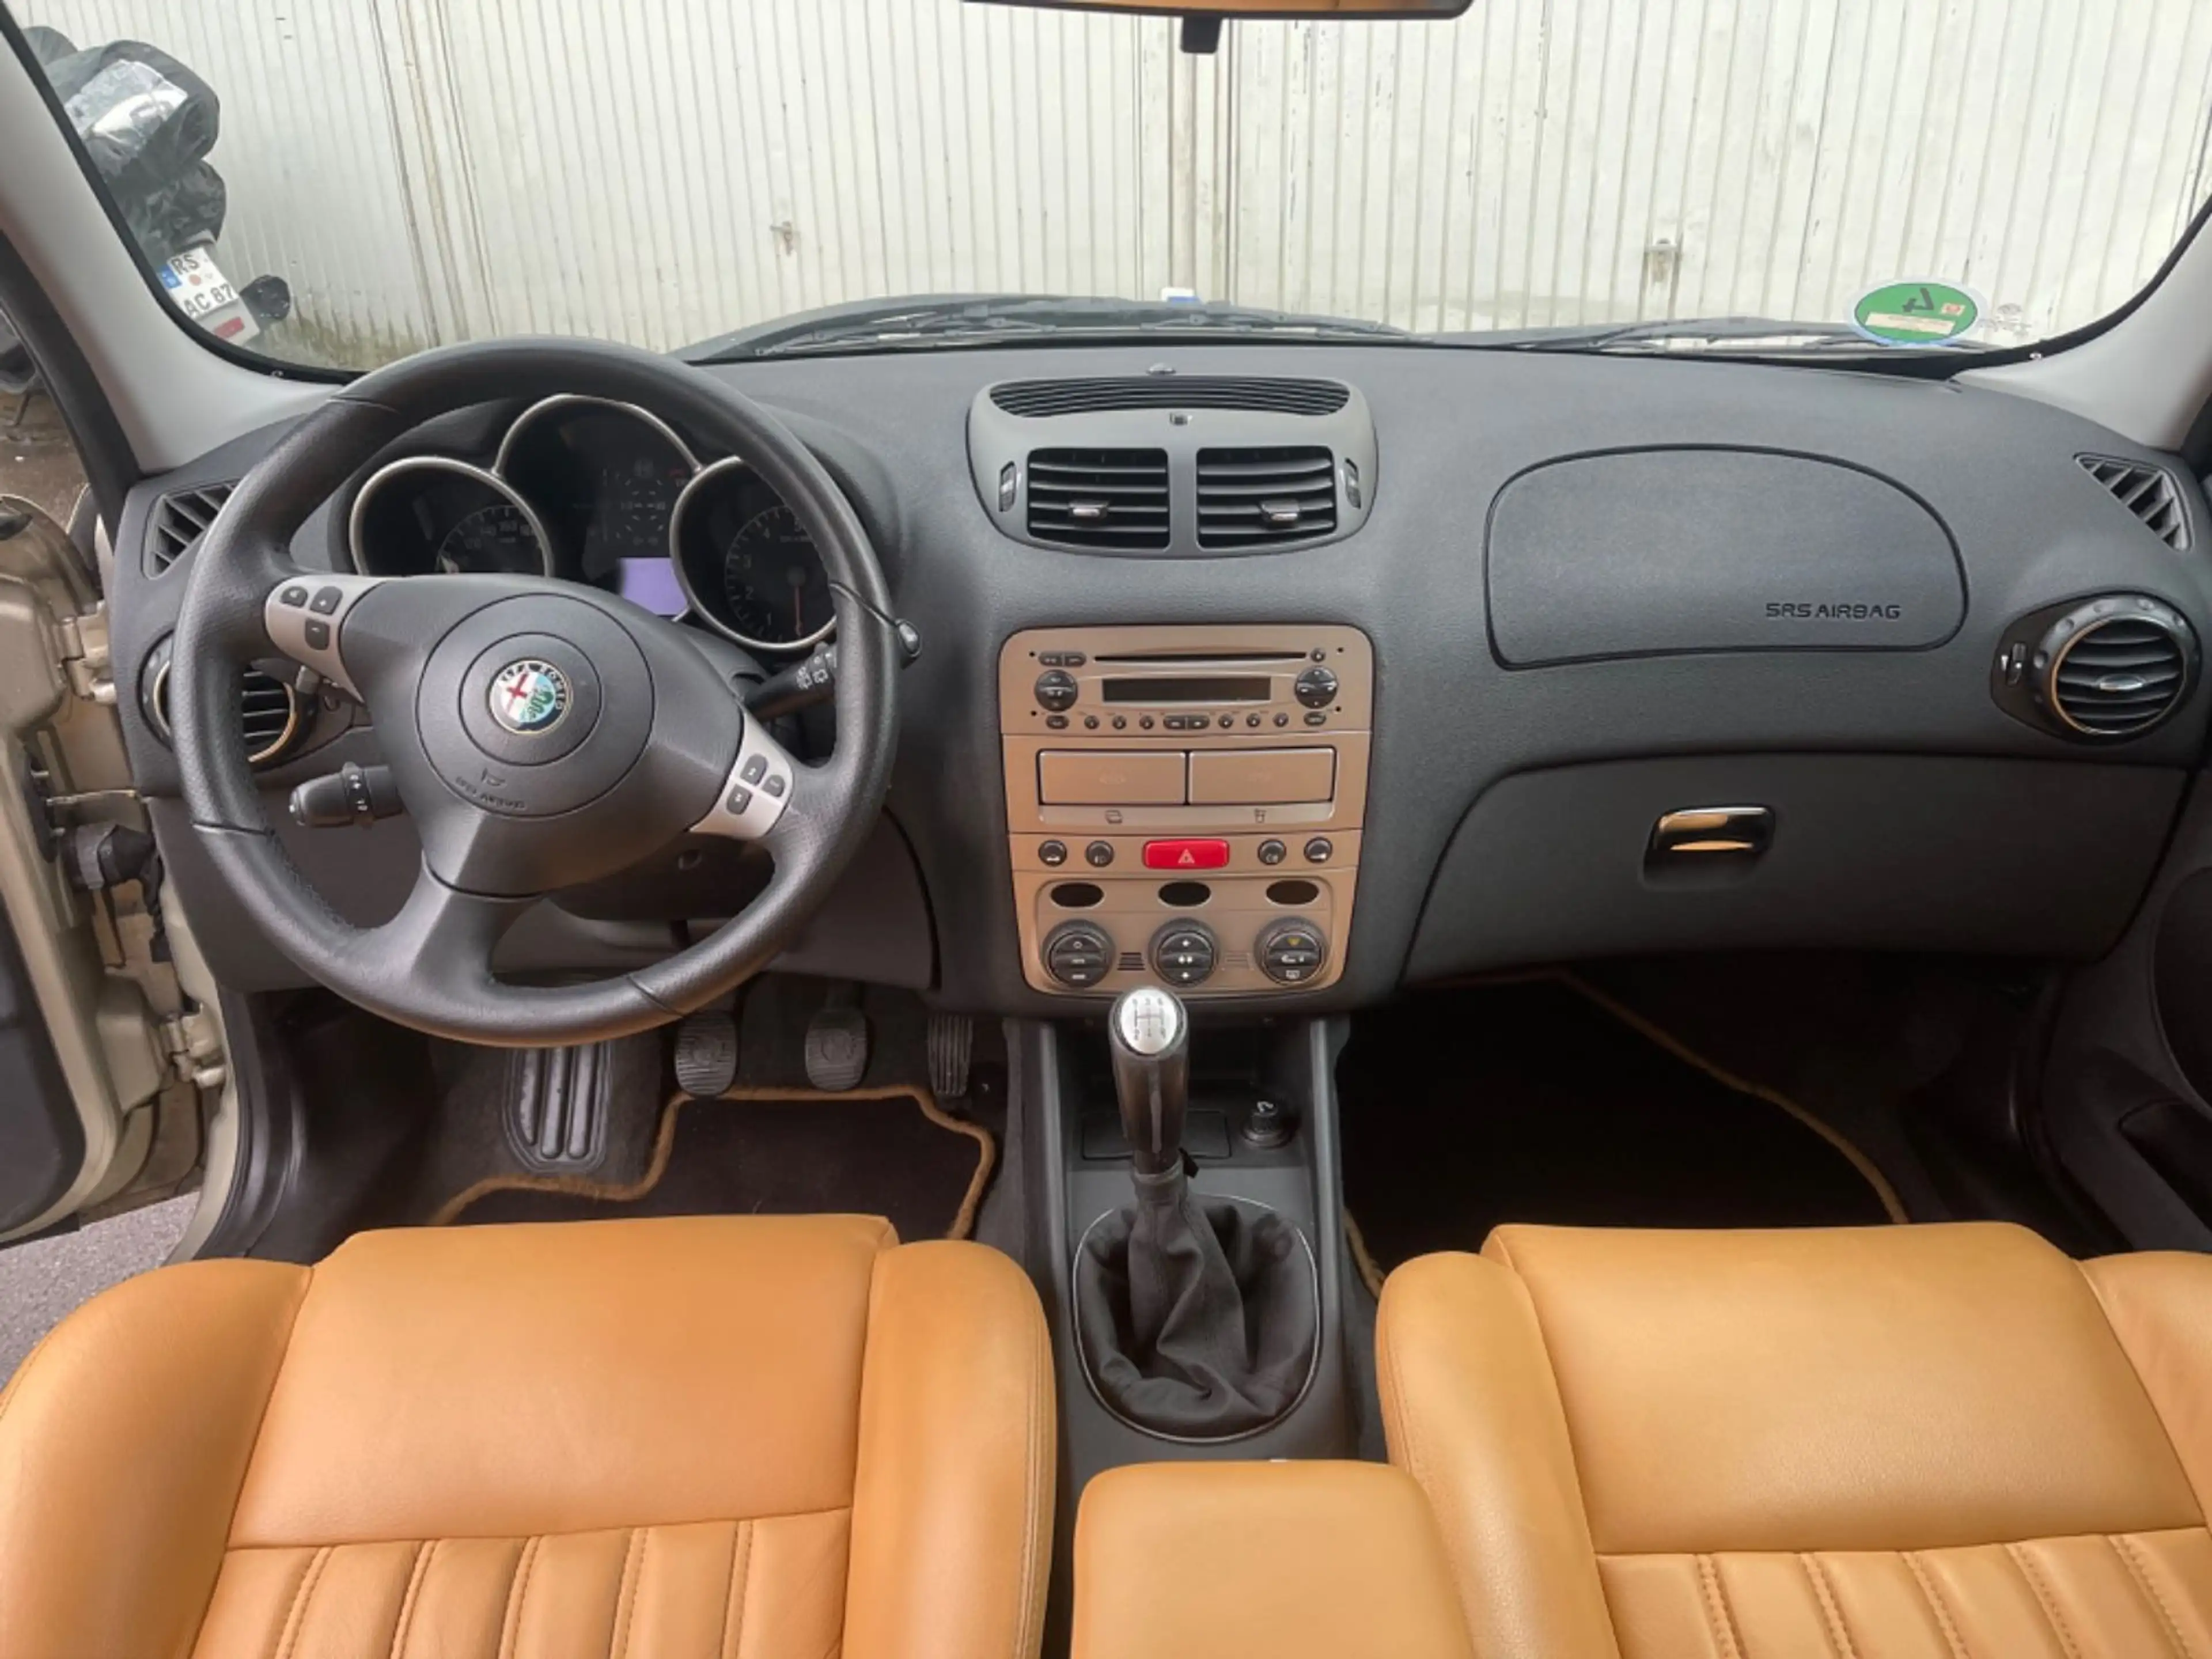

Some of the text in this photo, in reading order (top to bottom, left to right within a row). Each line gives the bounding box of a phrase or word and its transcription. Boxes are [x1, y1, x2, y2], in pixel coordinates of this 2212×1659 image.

[171, 255, 200, 275] RS
[183, 293, 211, 317] AC
[1766, 603, 1900, 619] SRS AIRBAG
